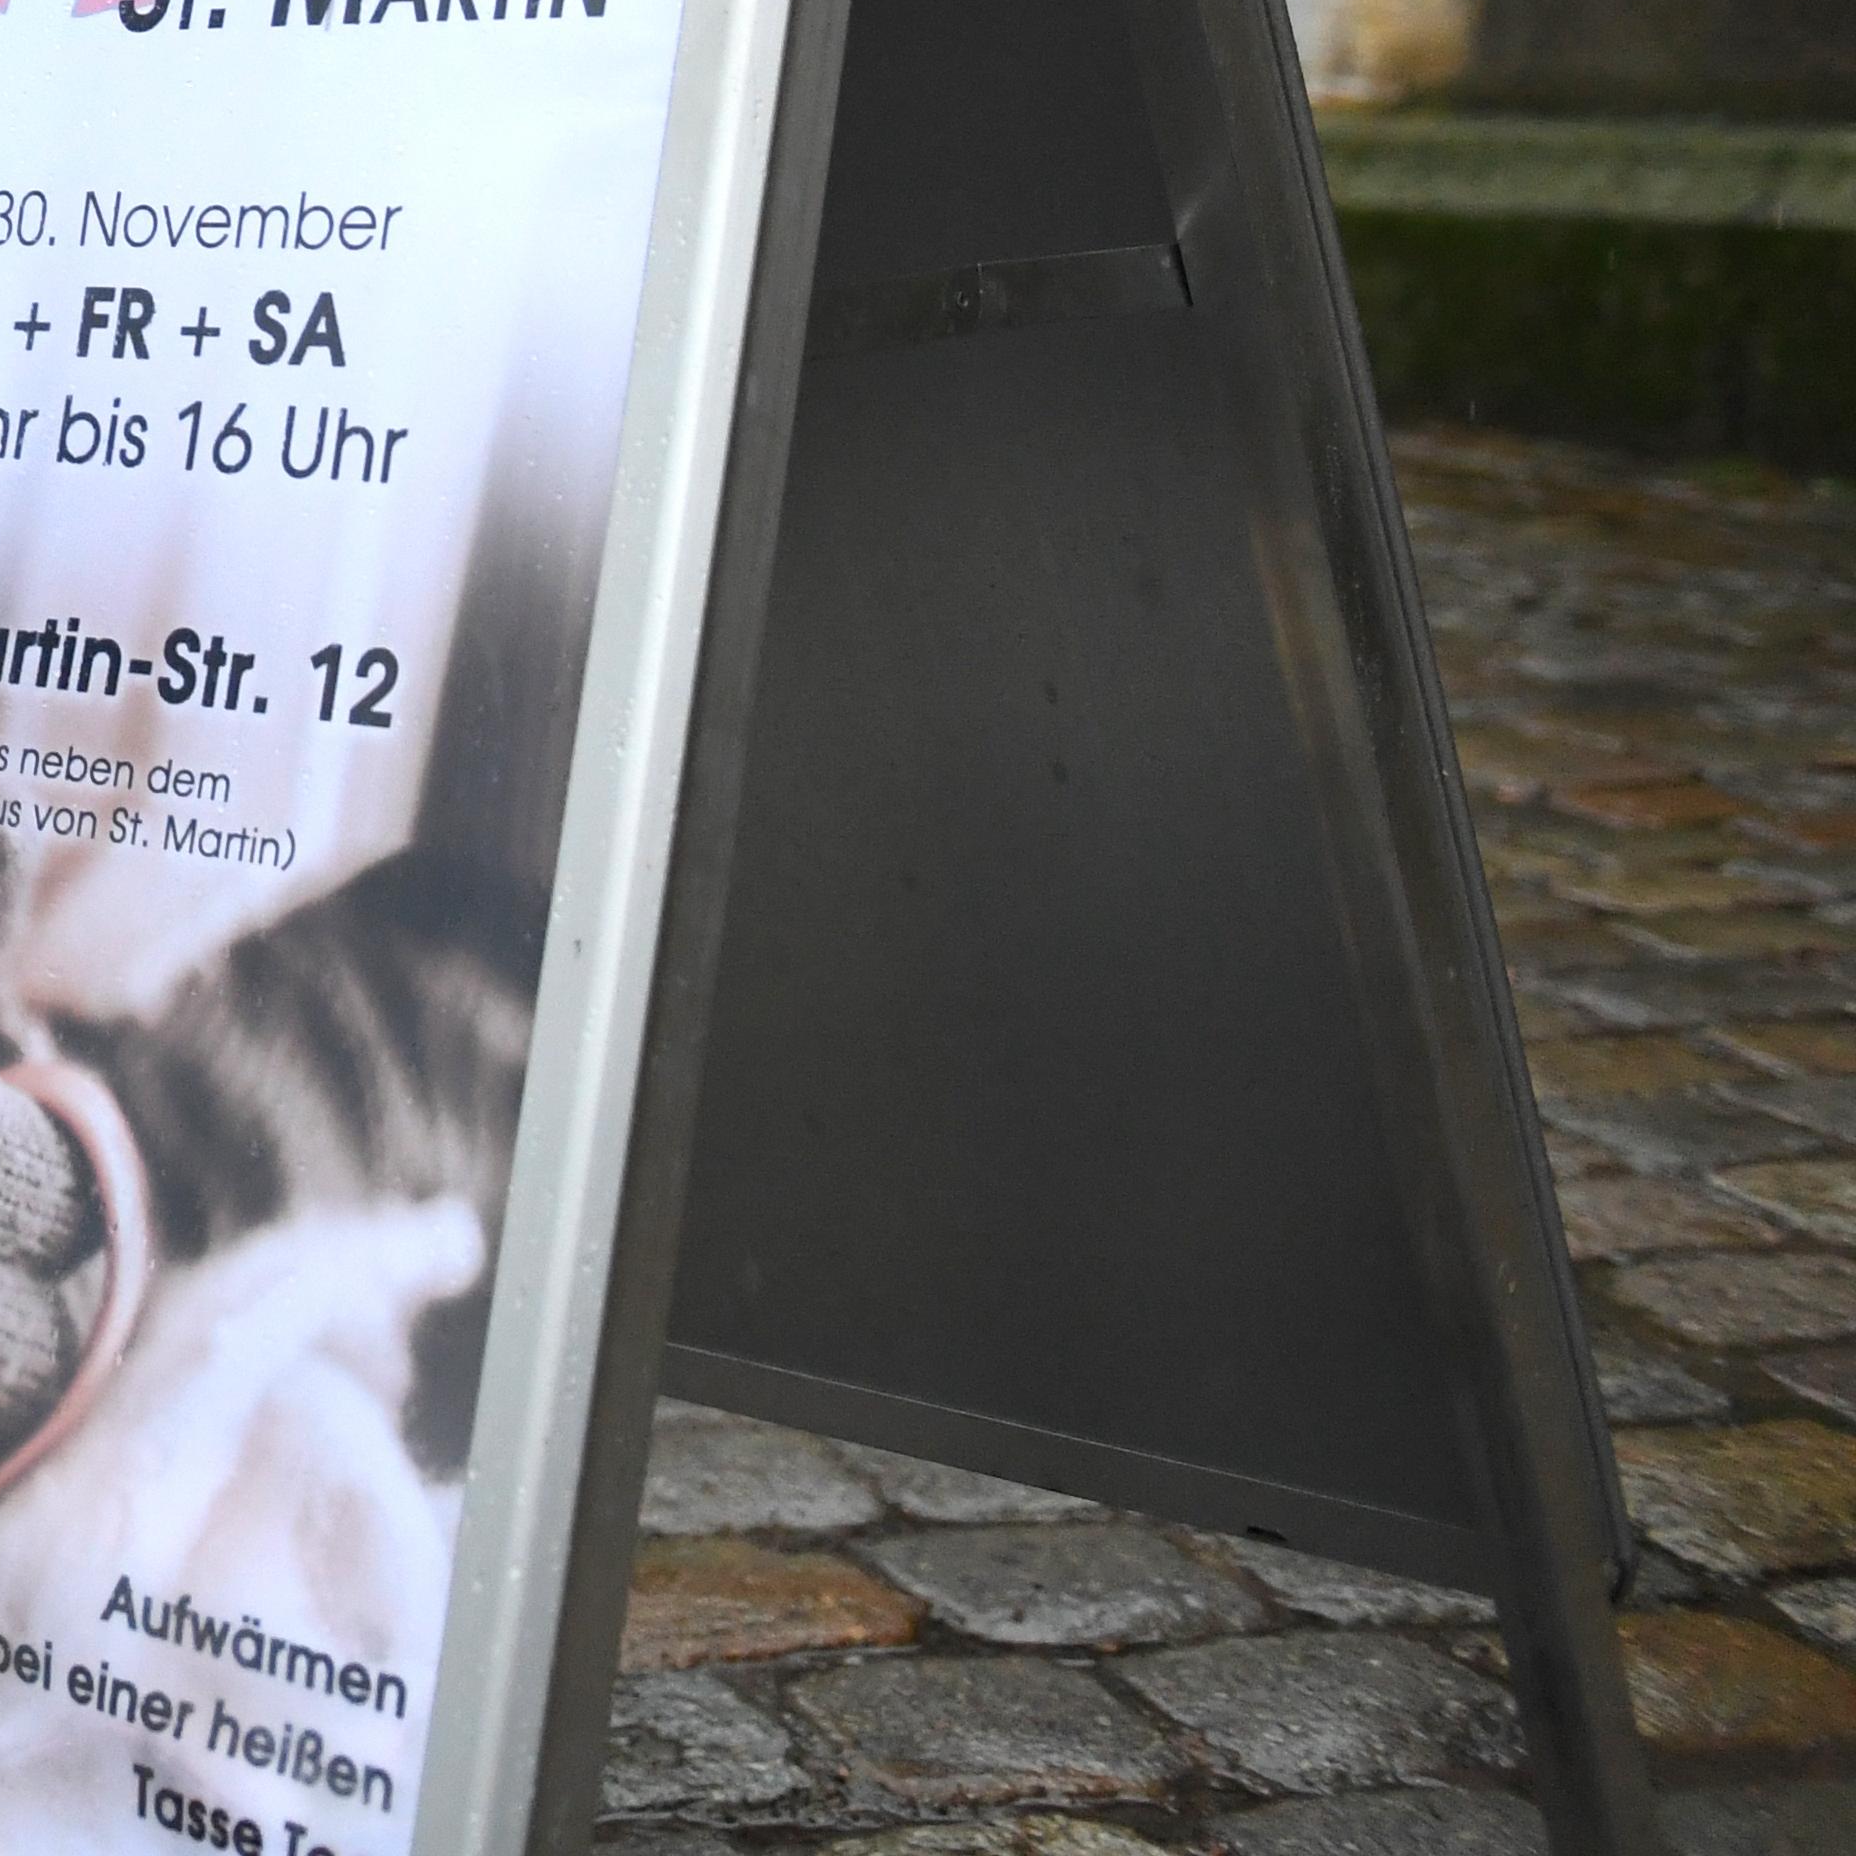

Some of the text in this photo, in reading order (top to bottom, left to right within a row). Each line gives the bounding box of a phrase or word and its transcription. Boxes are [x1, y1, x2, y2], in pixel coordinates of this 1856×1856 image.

[79, 190, 404, 252] November
[12, 301, 52, 352] +
[75, 285, 157, 361] FR
[179, 305, 222, 358] +
[247, 288, 347, 368] SA
[55, 393, 150, 469] bis
[176, 399, 253, 475] 16
[280, 404, 410, 485] Uhr
[309, 642, 402, 729] 12
[18, 745, 135, 791] neben
[145, 763, 232, 804] dem
[32, 803, 98, 841] von
[108, 806, 150, 849] St.
[162, 814, 298, 872] Martin)
[98, 1573, 408, 1720] Aufwärmen
[66, 1661, 195, 1740] einer
[206, 1697, 394, 1813] heißen
[132, 1763, 264, 1856] Tasse
